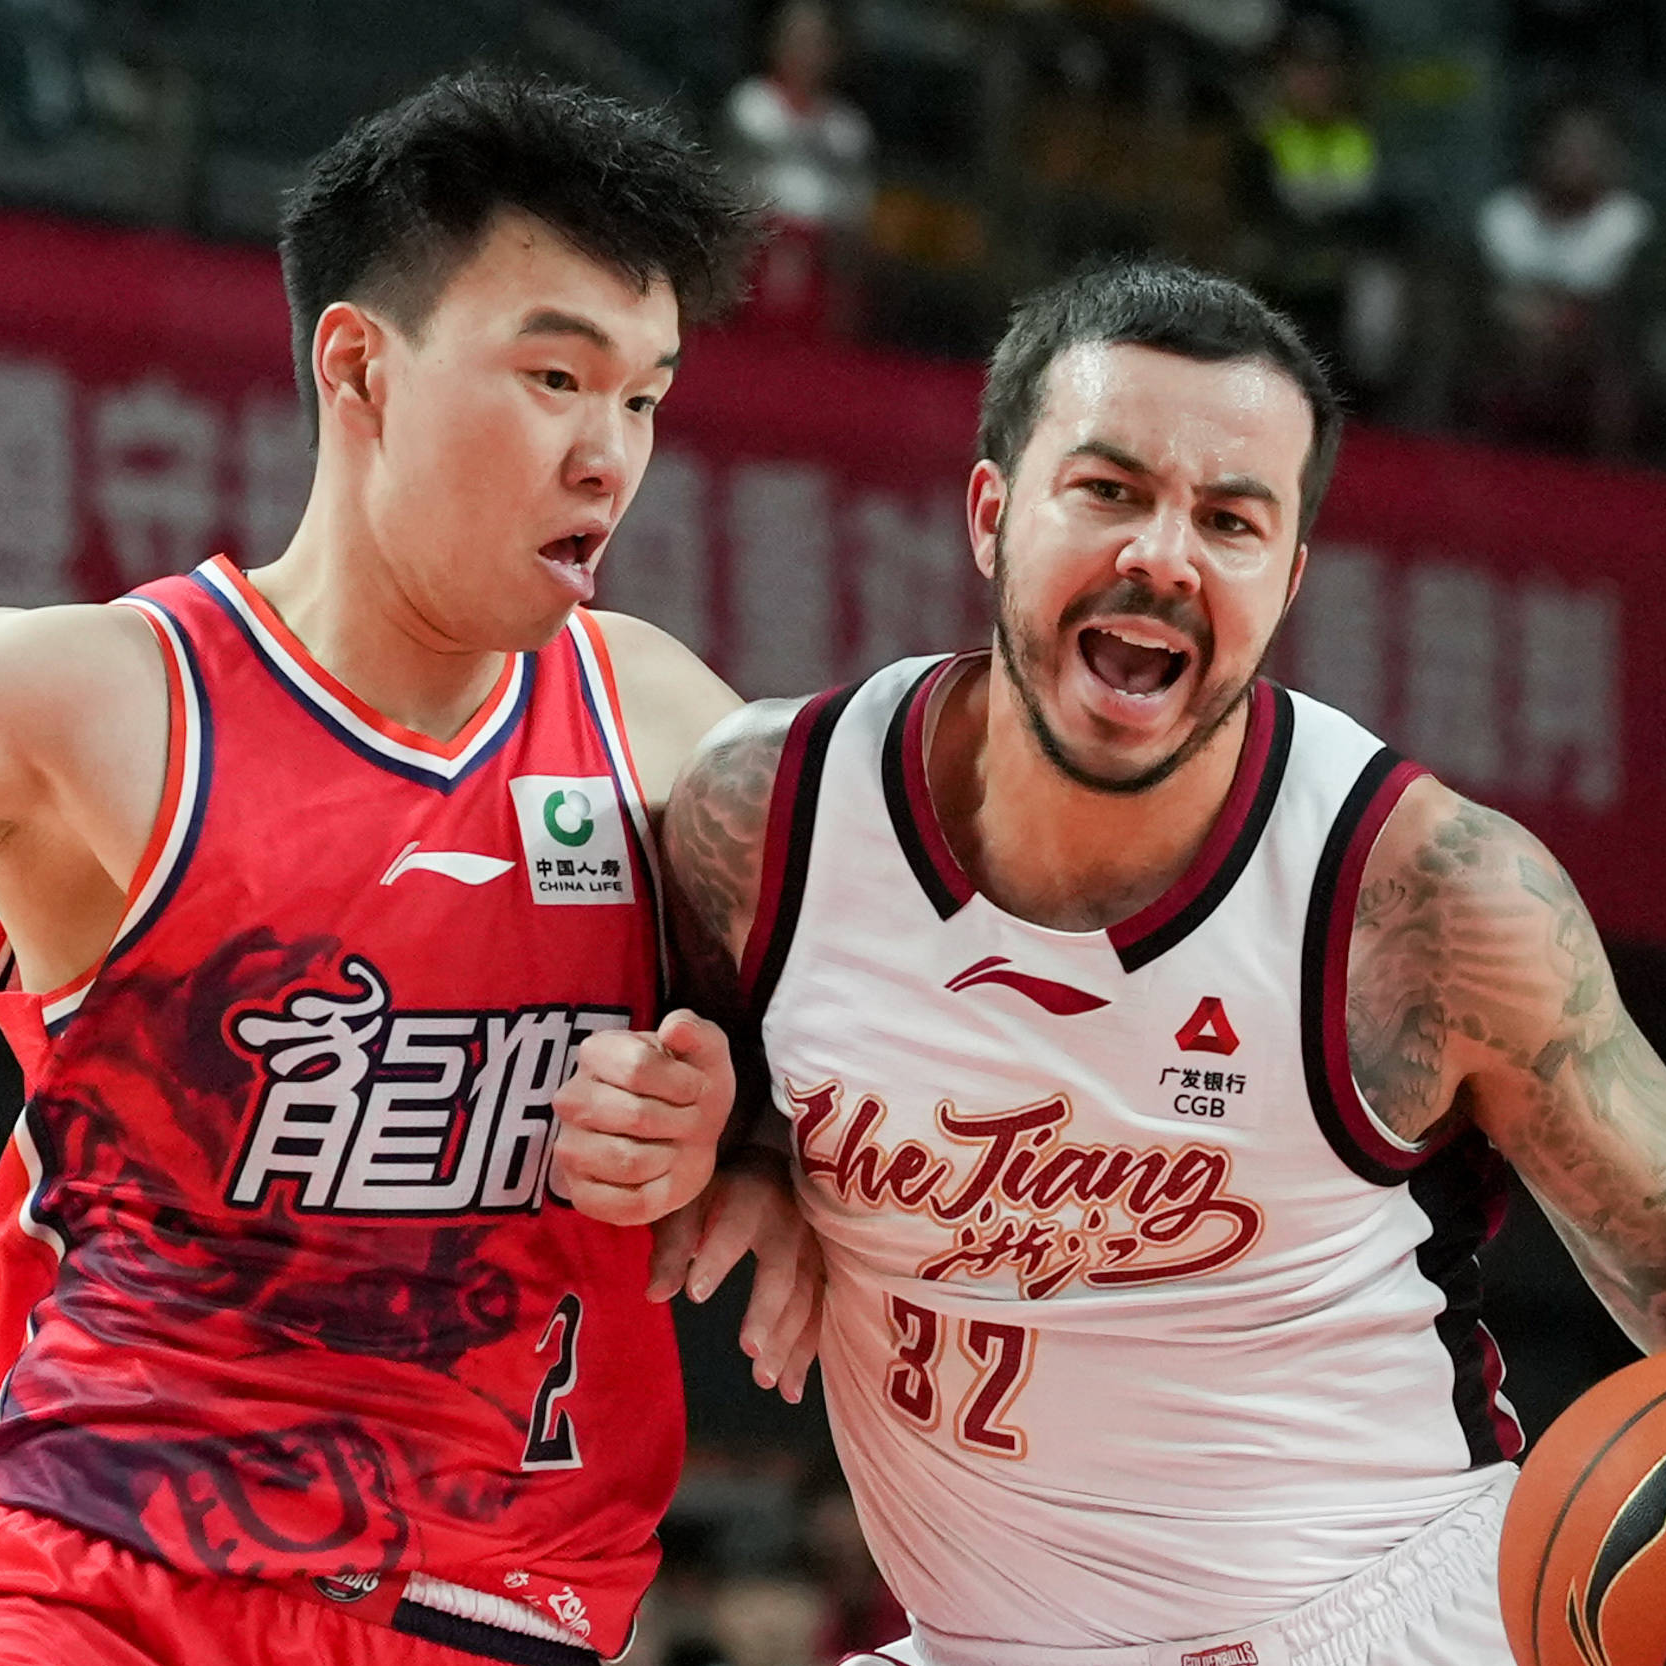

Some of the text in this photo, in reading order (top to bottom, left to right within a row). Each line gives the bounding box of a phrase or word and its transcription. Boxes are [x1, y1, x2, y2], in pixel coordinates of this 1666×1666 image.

[536, 857, 621, 878] 中国人寿
[539, 881, 623, 893] CHINA LIFE
[1159, 1067, 1247, 1095] 广发银行
[1174, 1094, 1226, 1118] CGB
[521, 1292, 583, 1470] 2
[884, 1290, 1036, 1462] 32
